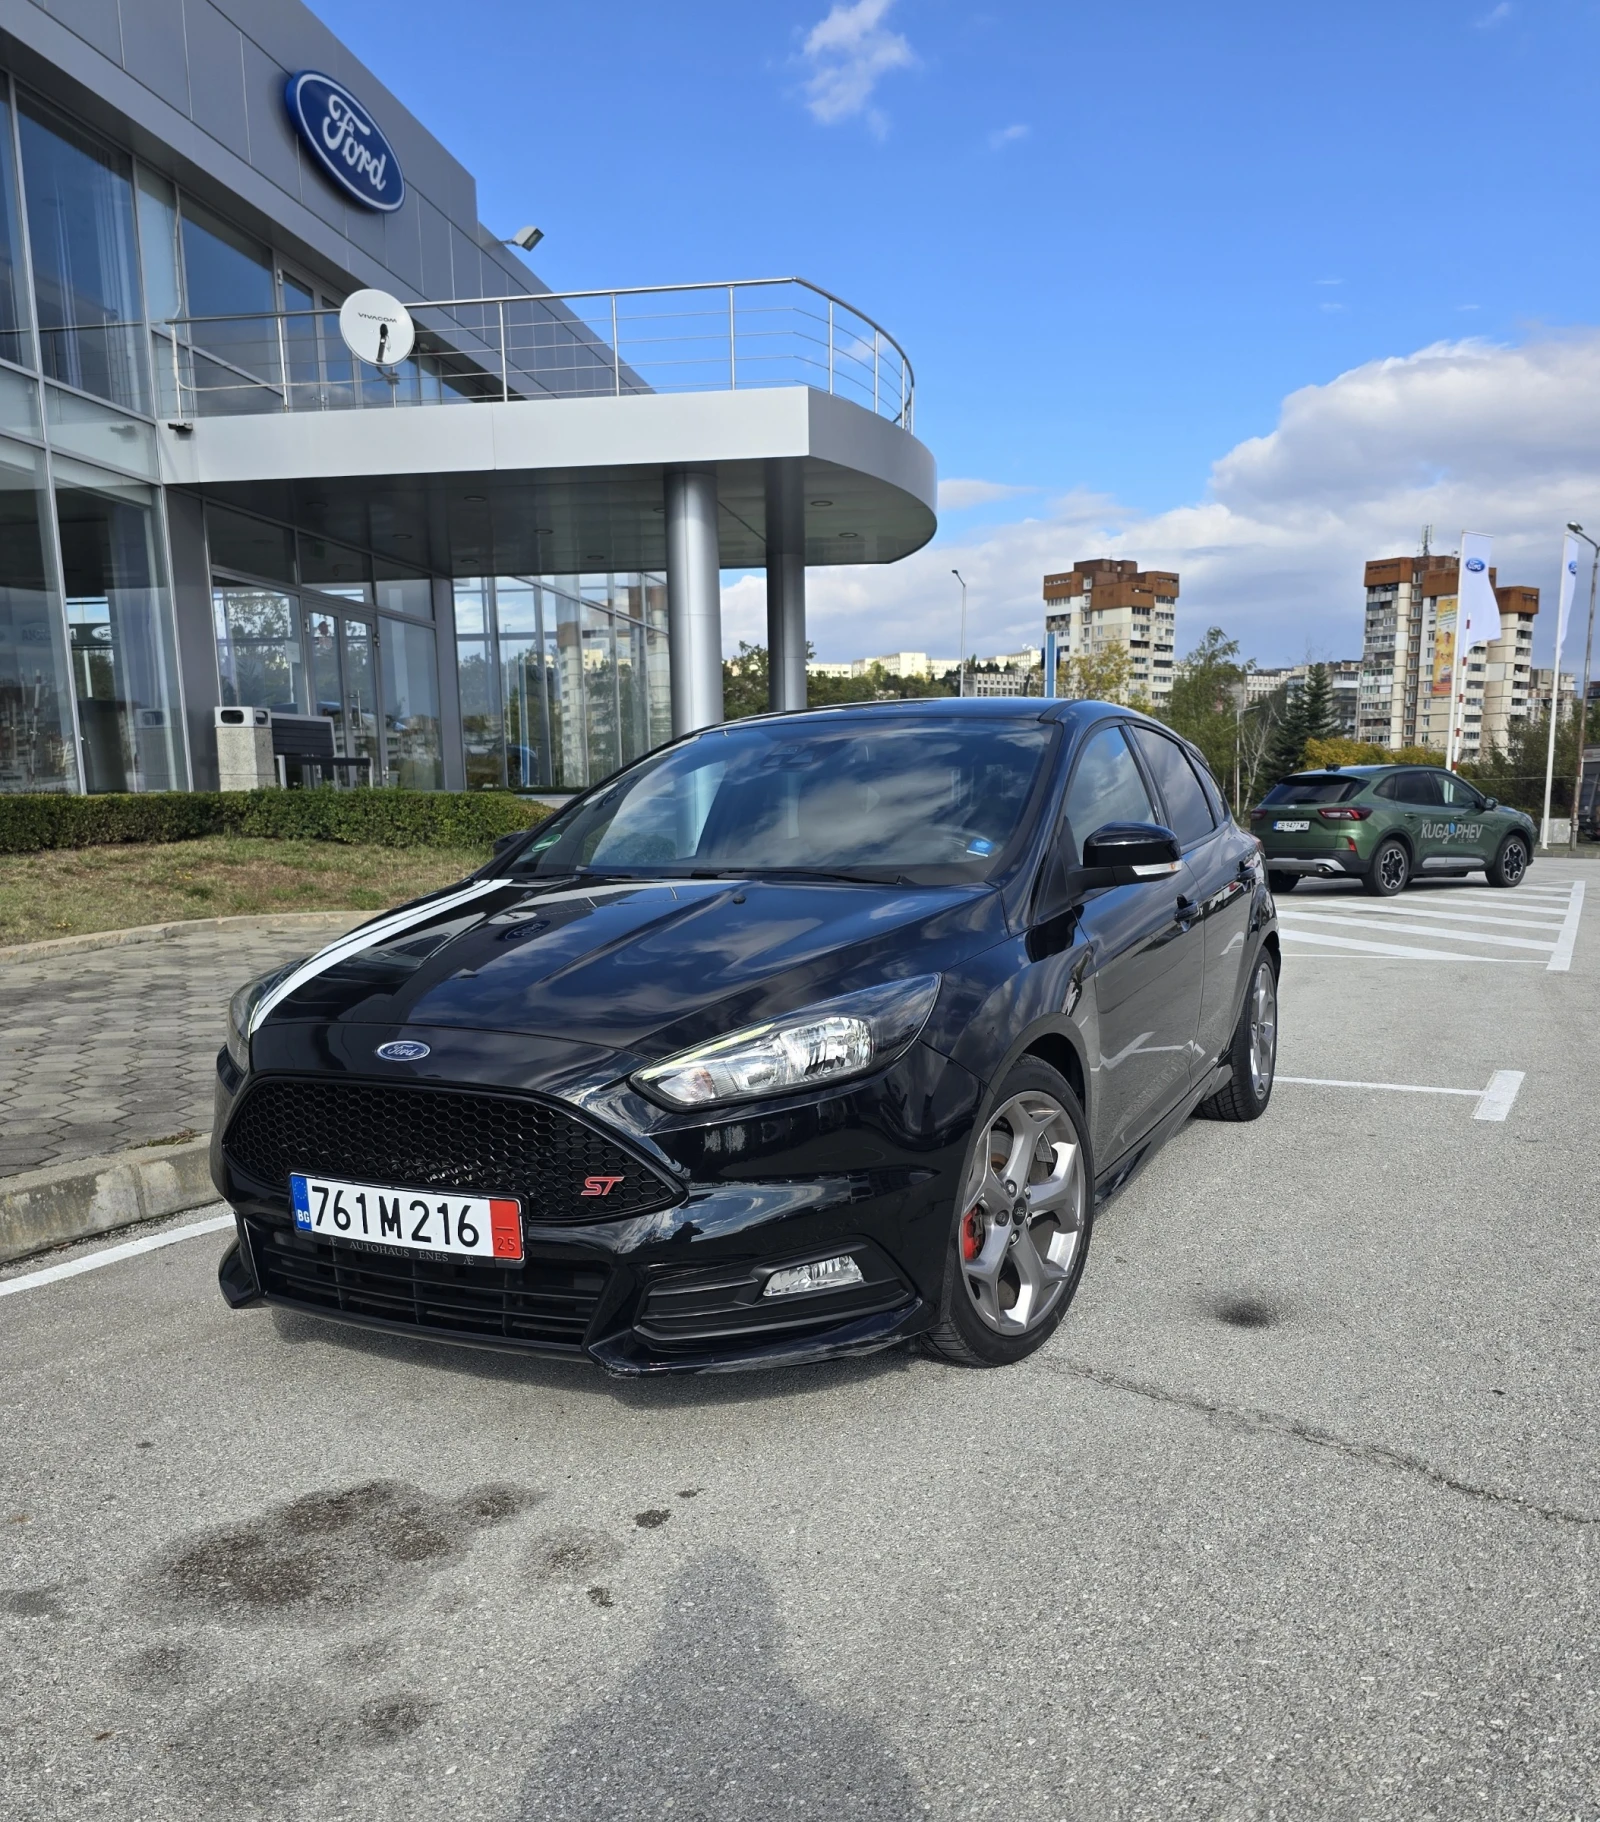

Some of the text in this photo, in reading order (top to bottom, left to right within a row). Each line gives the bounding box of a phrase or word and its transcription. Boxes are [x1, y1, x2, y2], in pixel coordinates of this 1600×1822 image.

[322, 94, 387, 191] Ford
[357, 312, 397, 323] VIVACOM
[1421, 823, 1484, 839] KUGA PHEV
[387, 1044, 419, 1056] Ford
[580, 1176, 625, 1196] ST
[297, 1209, 310, 1224] BG
[349, 1240, 410, 1258] AUTOHAUS
[418, 1250, 449, 1262] ENES
[496, 1236, 516, 1252] 25
